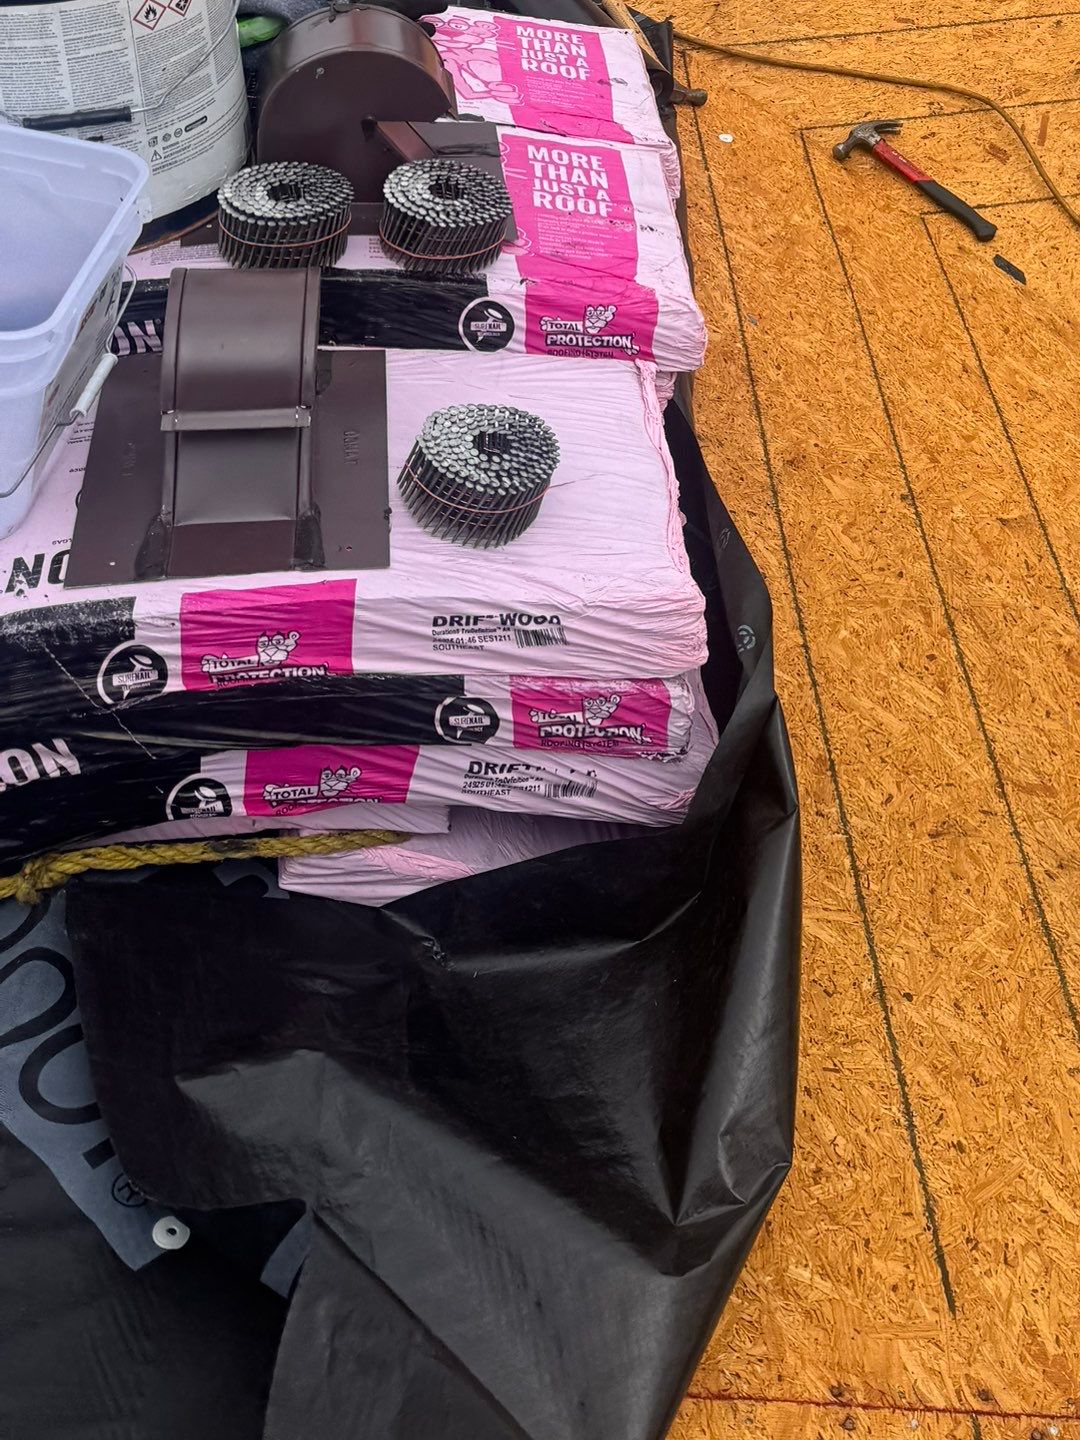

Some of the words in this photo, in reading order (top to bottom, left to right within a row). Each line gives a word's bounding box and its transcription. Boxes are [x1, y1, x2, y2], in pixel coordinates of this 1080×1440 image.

[516, 25, 583, 45] MORE
[520, 36, 587, 58] THAN
[521, 49, 569, 64] JUST
[576, 59, 590, 69] A
[521, 59, 591, 81] ROOF
[527, 144, 607, 171] MORE
[529, 160, 609, 189] THAN
[532, 178, 587, 198] JUST
[596, 189, 611, 202] A
[532, 190, 613, 217] ROOF
[549, 321, 581, 332] TOTAL
[546, 334, 632, 348] PROTECTION
[210, 658, 253, 669] TOTAL
[540, 725, 641, 739] PROTECTION
[541, 740, 581, 748] ROOFING
[273, 787, 314, 800] TOTAL
